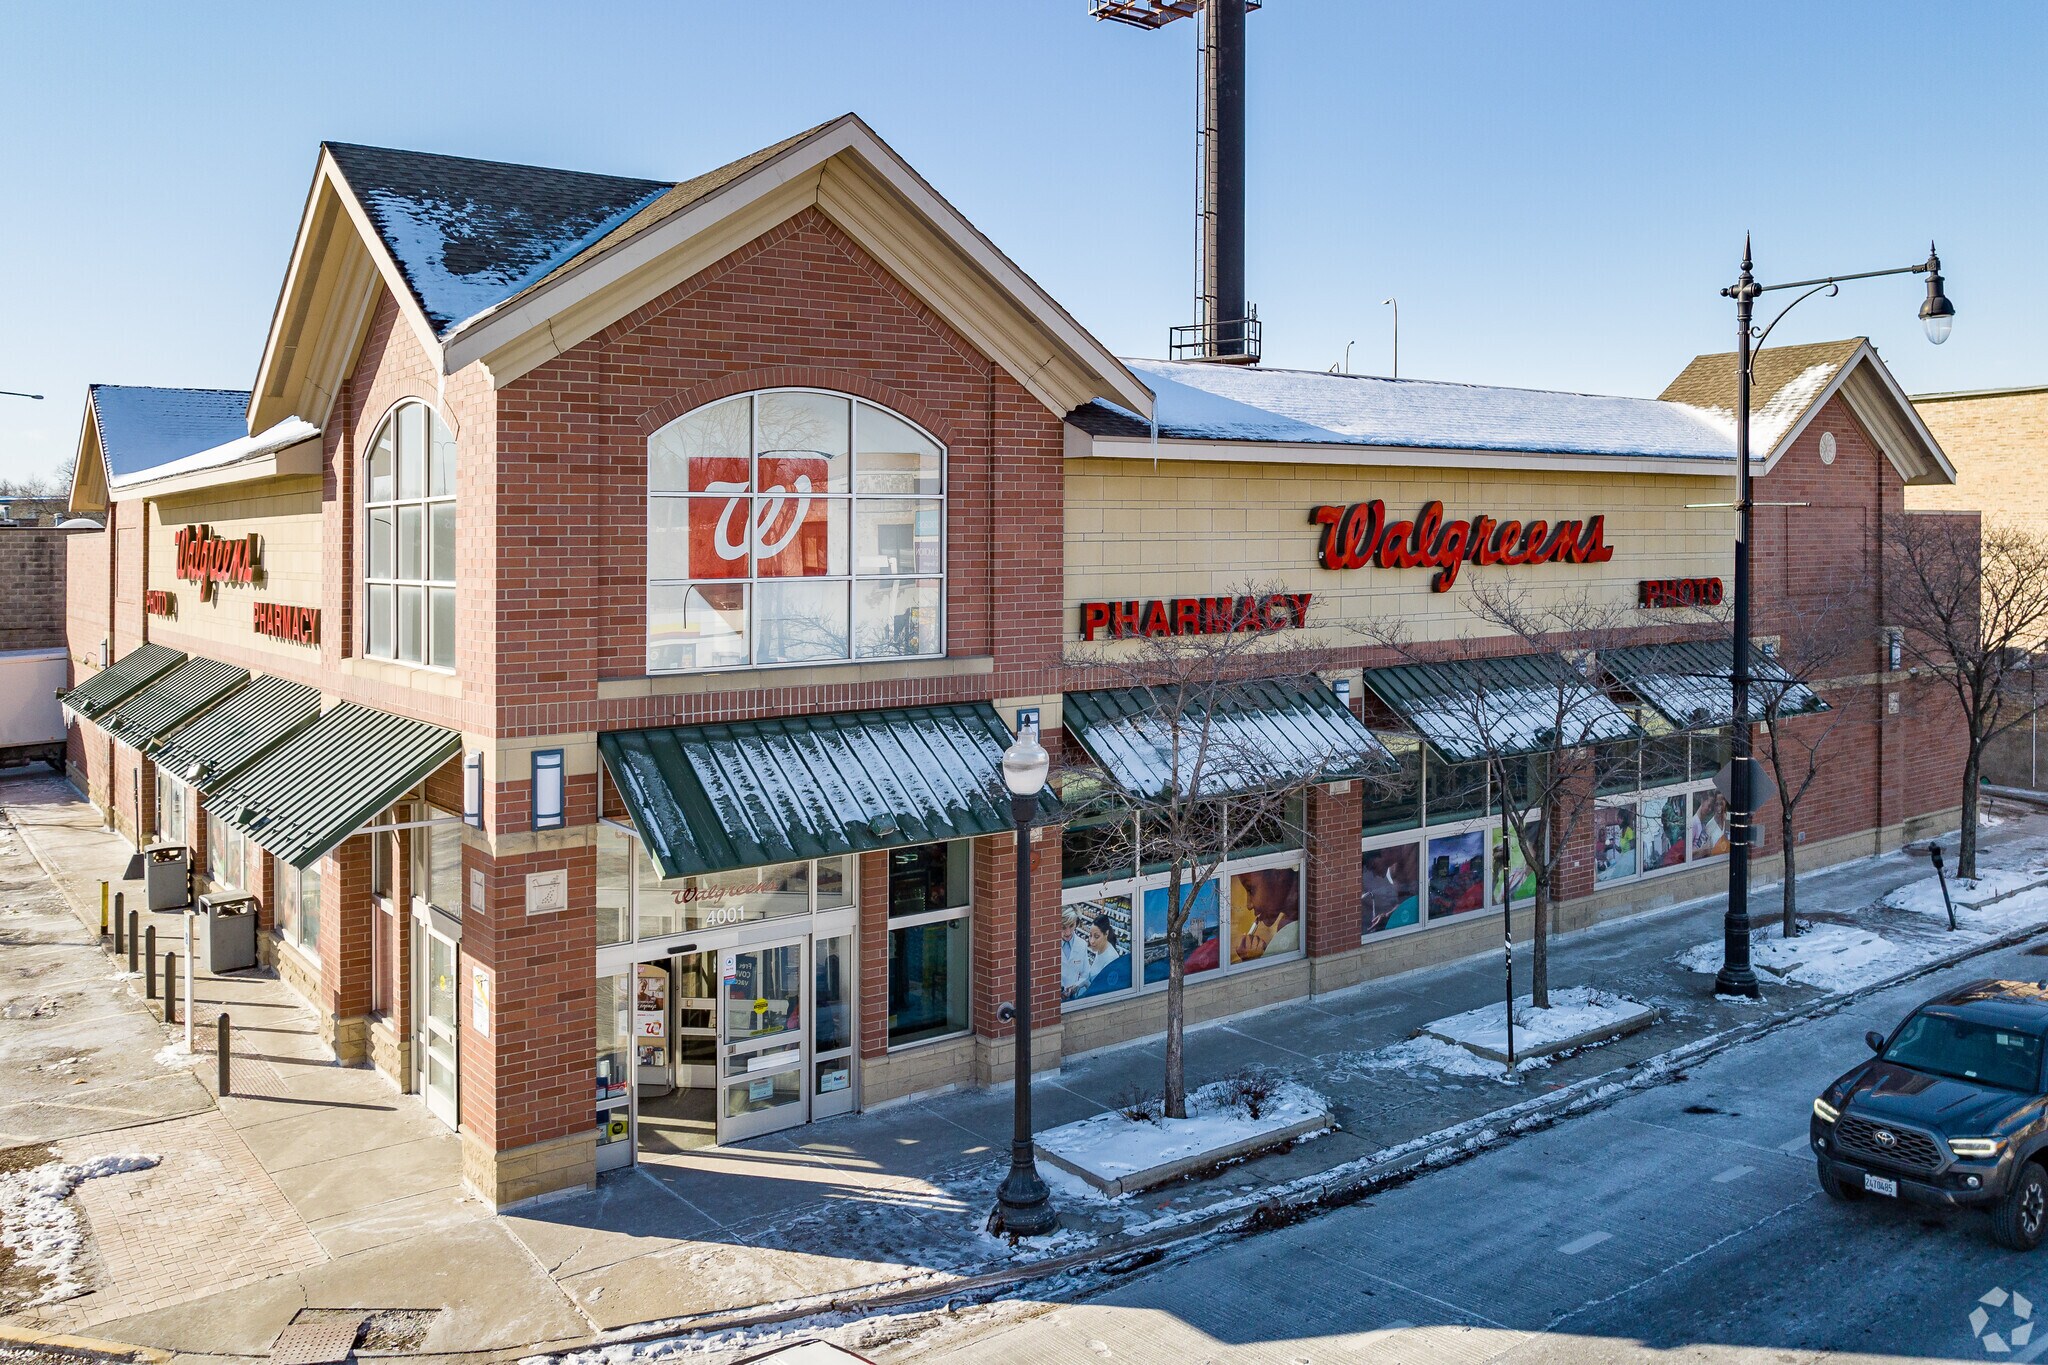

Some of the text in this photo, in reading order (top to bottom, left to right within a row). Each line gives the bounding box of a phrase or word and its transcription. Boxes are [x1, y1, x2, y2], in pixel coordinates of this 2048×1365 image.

[175, 524, 260, 602] Walgreens
[1308, 499, 1613, 593] Walgreens
[146, 590, 171, 616] PHOTO
[1639, 577, 1723, 609] PHOTO
[253, 602, 321, 645] PHARMACY
[1080, 594, 1312, 641] PHARMACY
[671, 880, 779, 904] Walgreens
[706, 905, 745, 925] 4001
